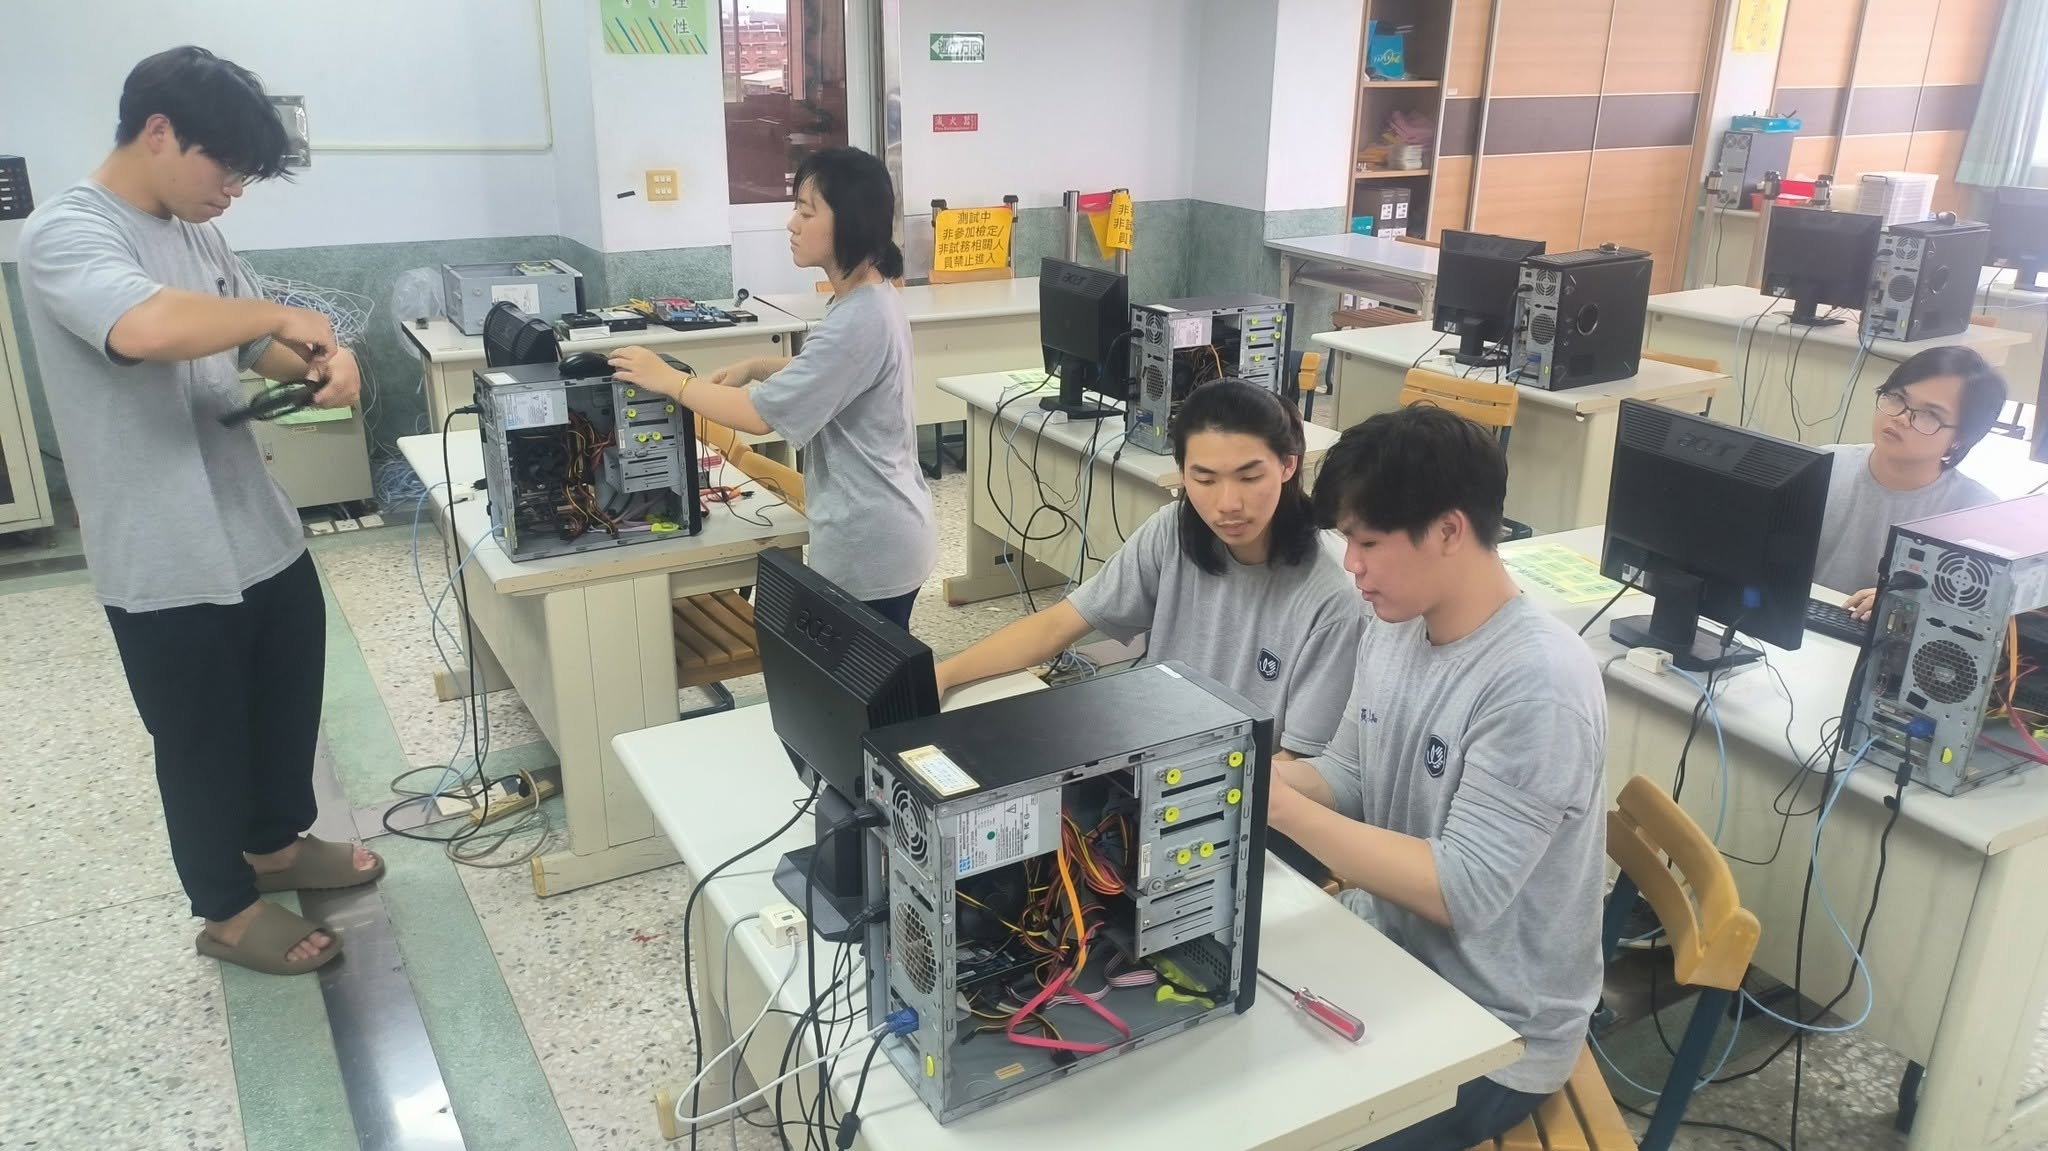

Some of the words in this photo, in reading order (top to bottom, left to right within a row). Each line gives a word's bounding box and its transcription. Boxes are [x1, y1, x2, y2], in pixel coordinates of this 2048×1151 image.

[957, 210, 991, 225] 測試中
[1117, 231, 1133, 246] 員
[938, 239, 1005, 256] 非試務相關人
[944, 253, 996, 270] 員禁止進入
[795, 608, 841, 652] acer
